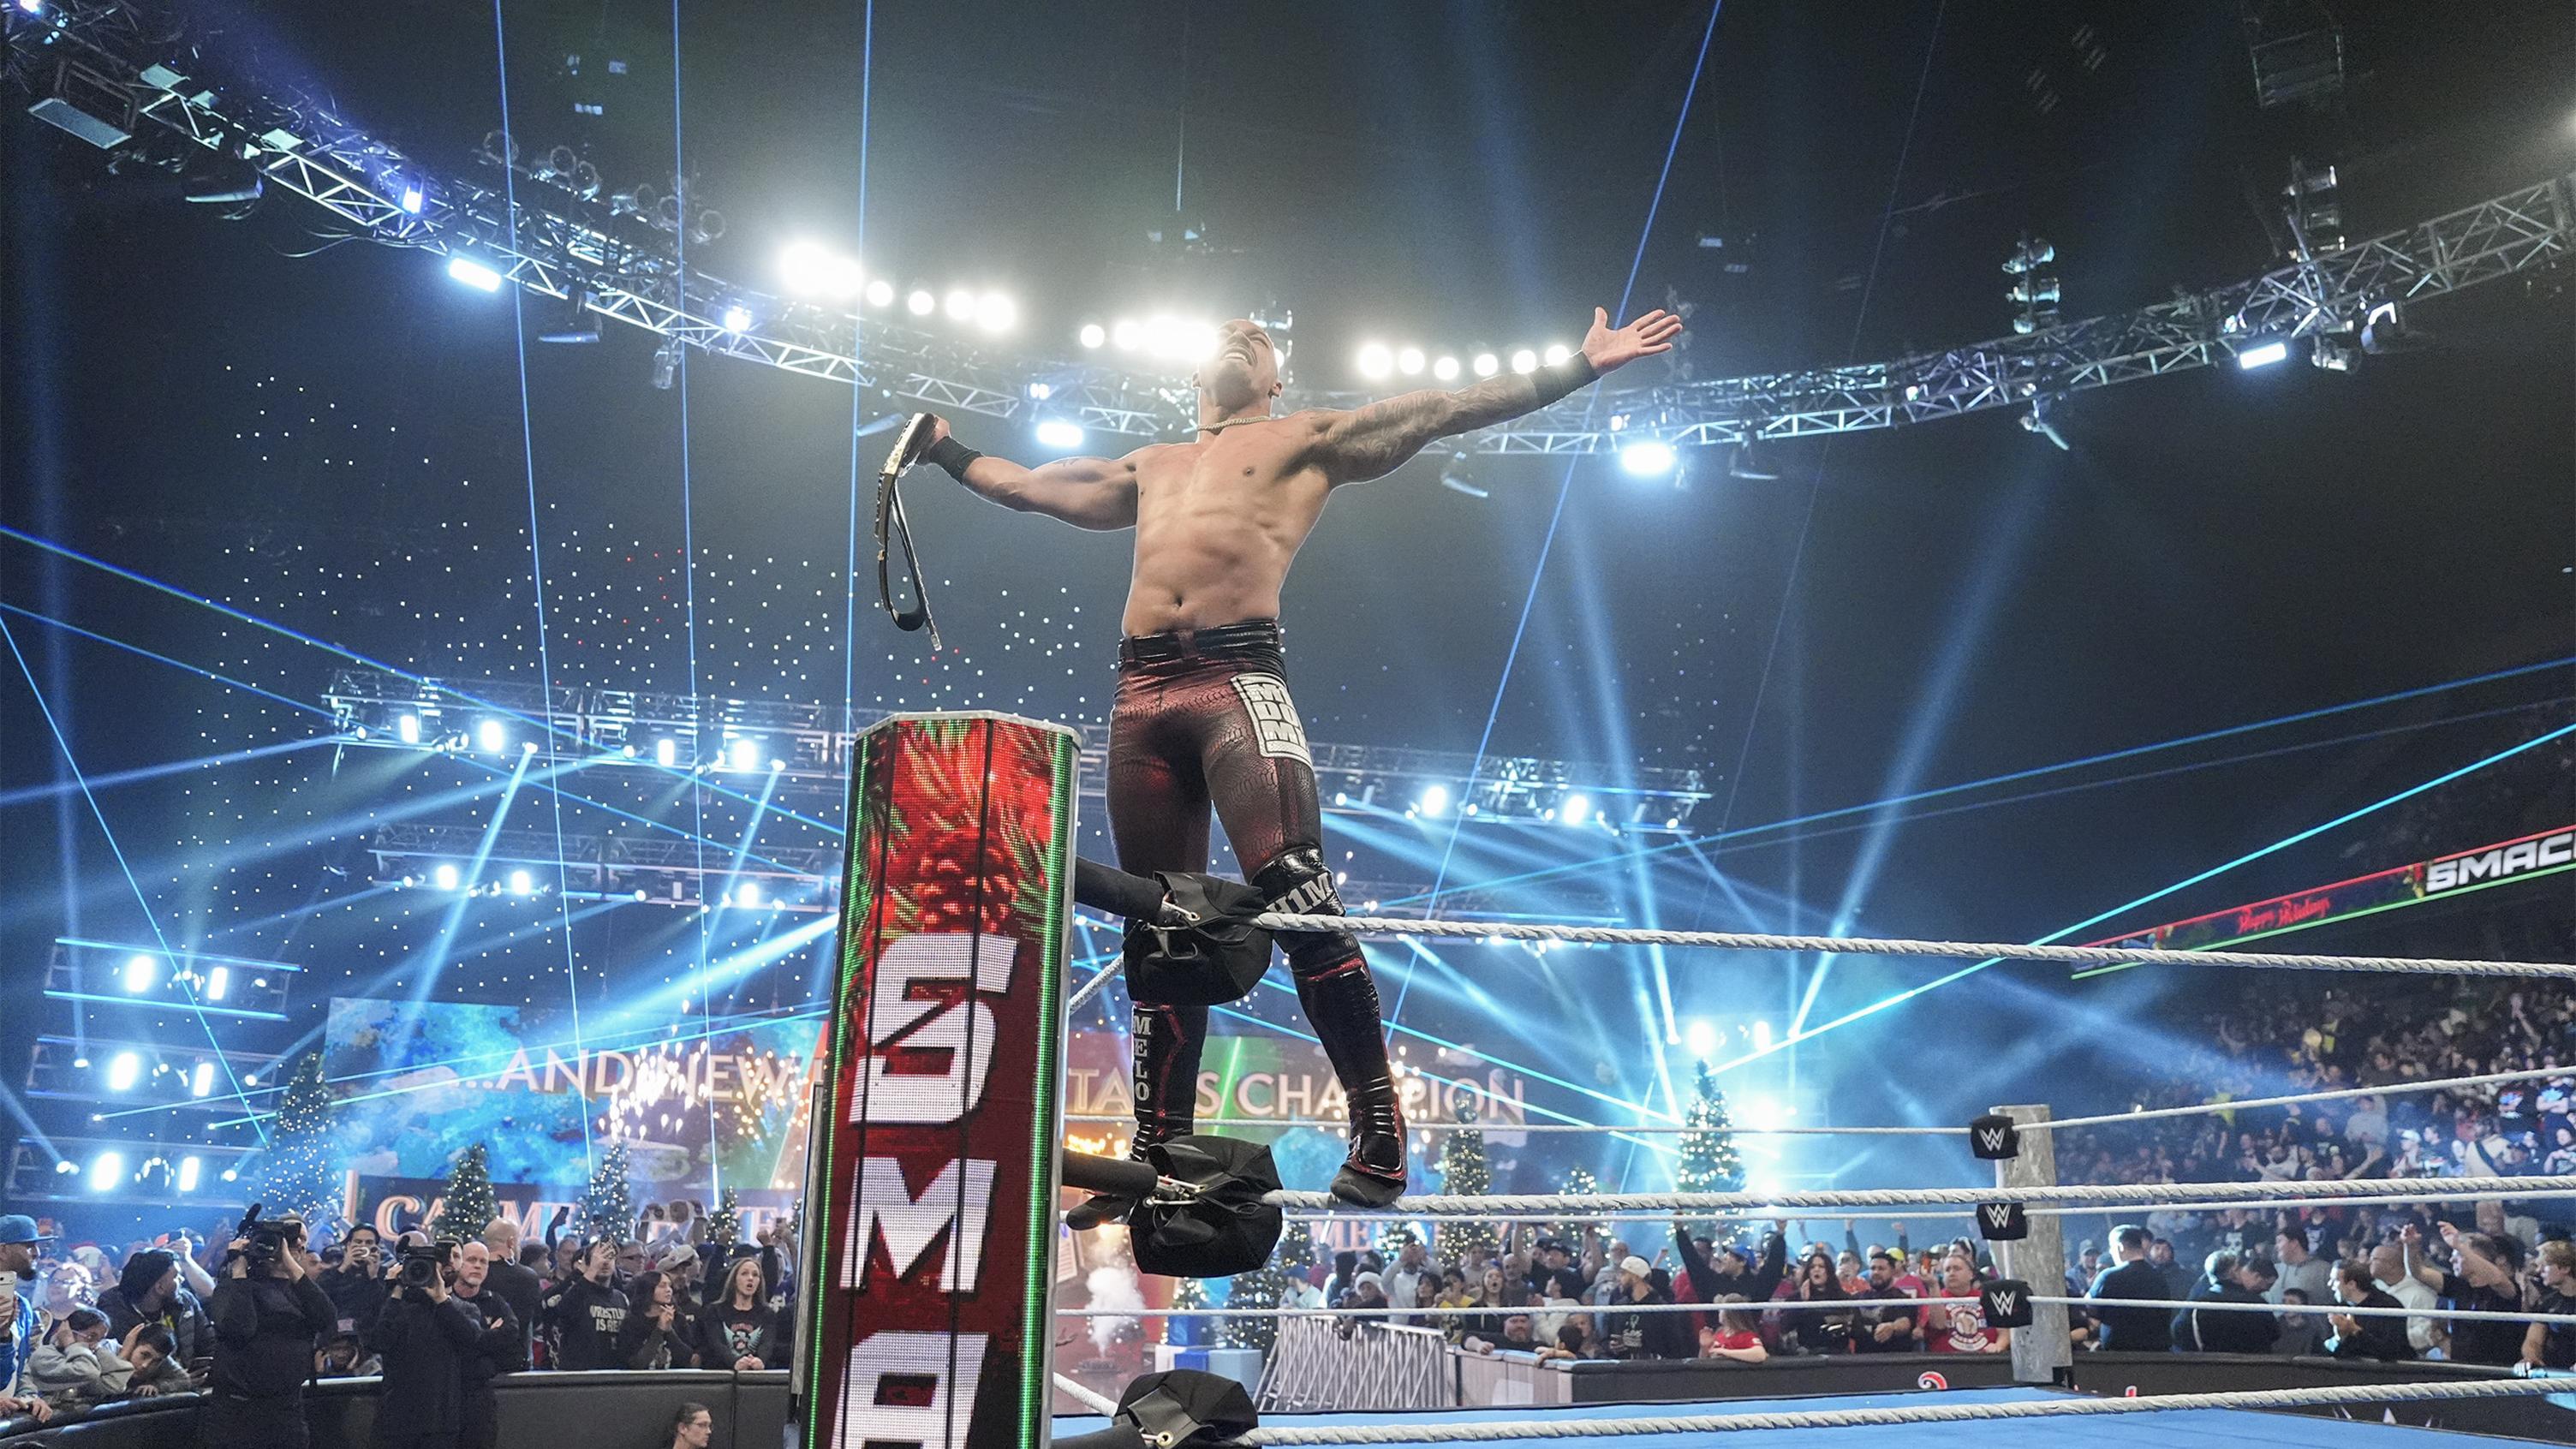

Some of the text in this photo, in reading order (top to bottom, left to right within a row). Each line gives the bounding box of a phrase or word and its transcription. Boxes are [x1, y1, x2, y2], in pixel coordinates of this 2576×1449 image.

[2426, 832, 2576, 892] SMAC
[1132, 1014, 1153, 1102] MELO
[1237, 1069, 1525, 1124] CHAPION
[595, 1318, 606, 1332] IS
